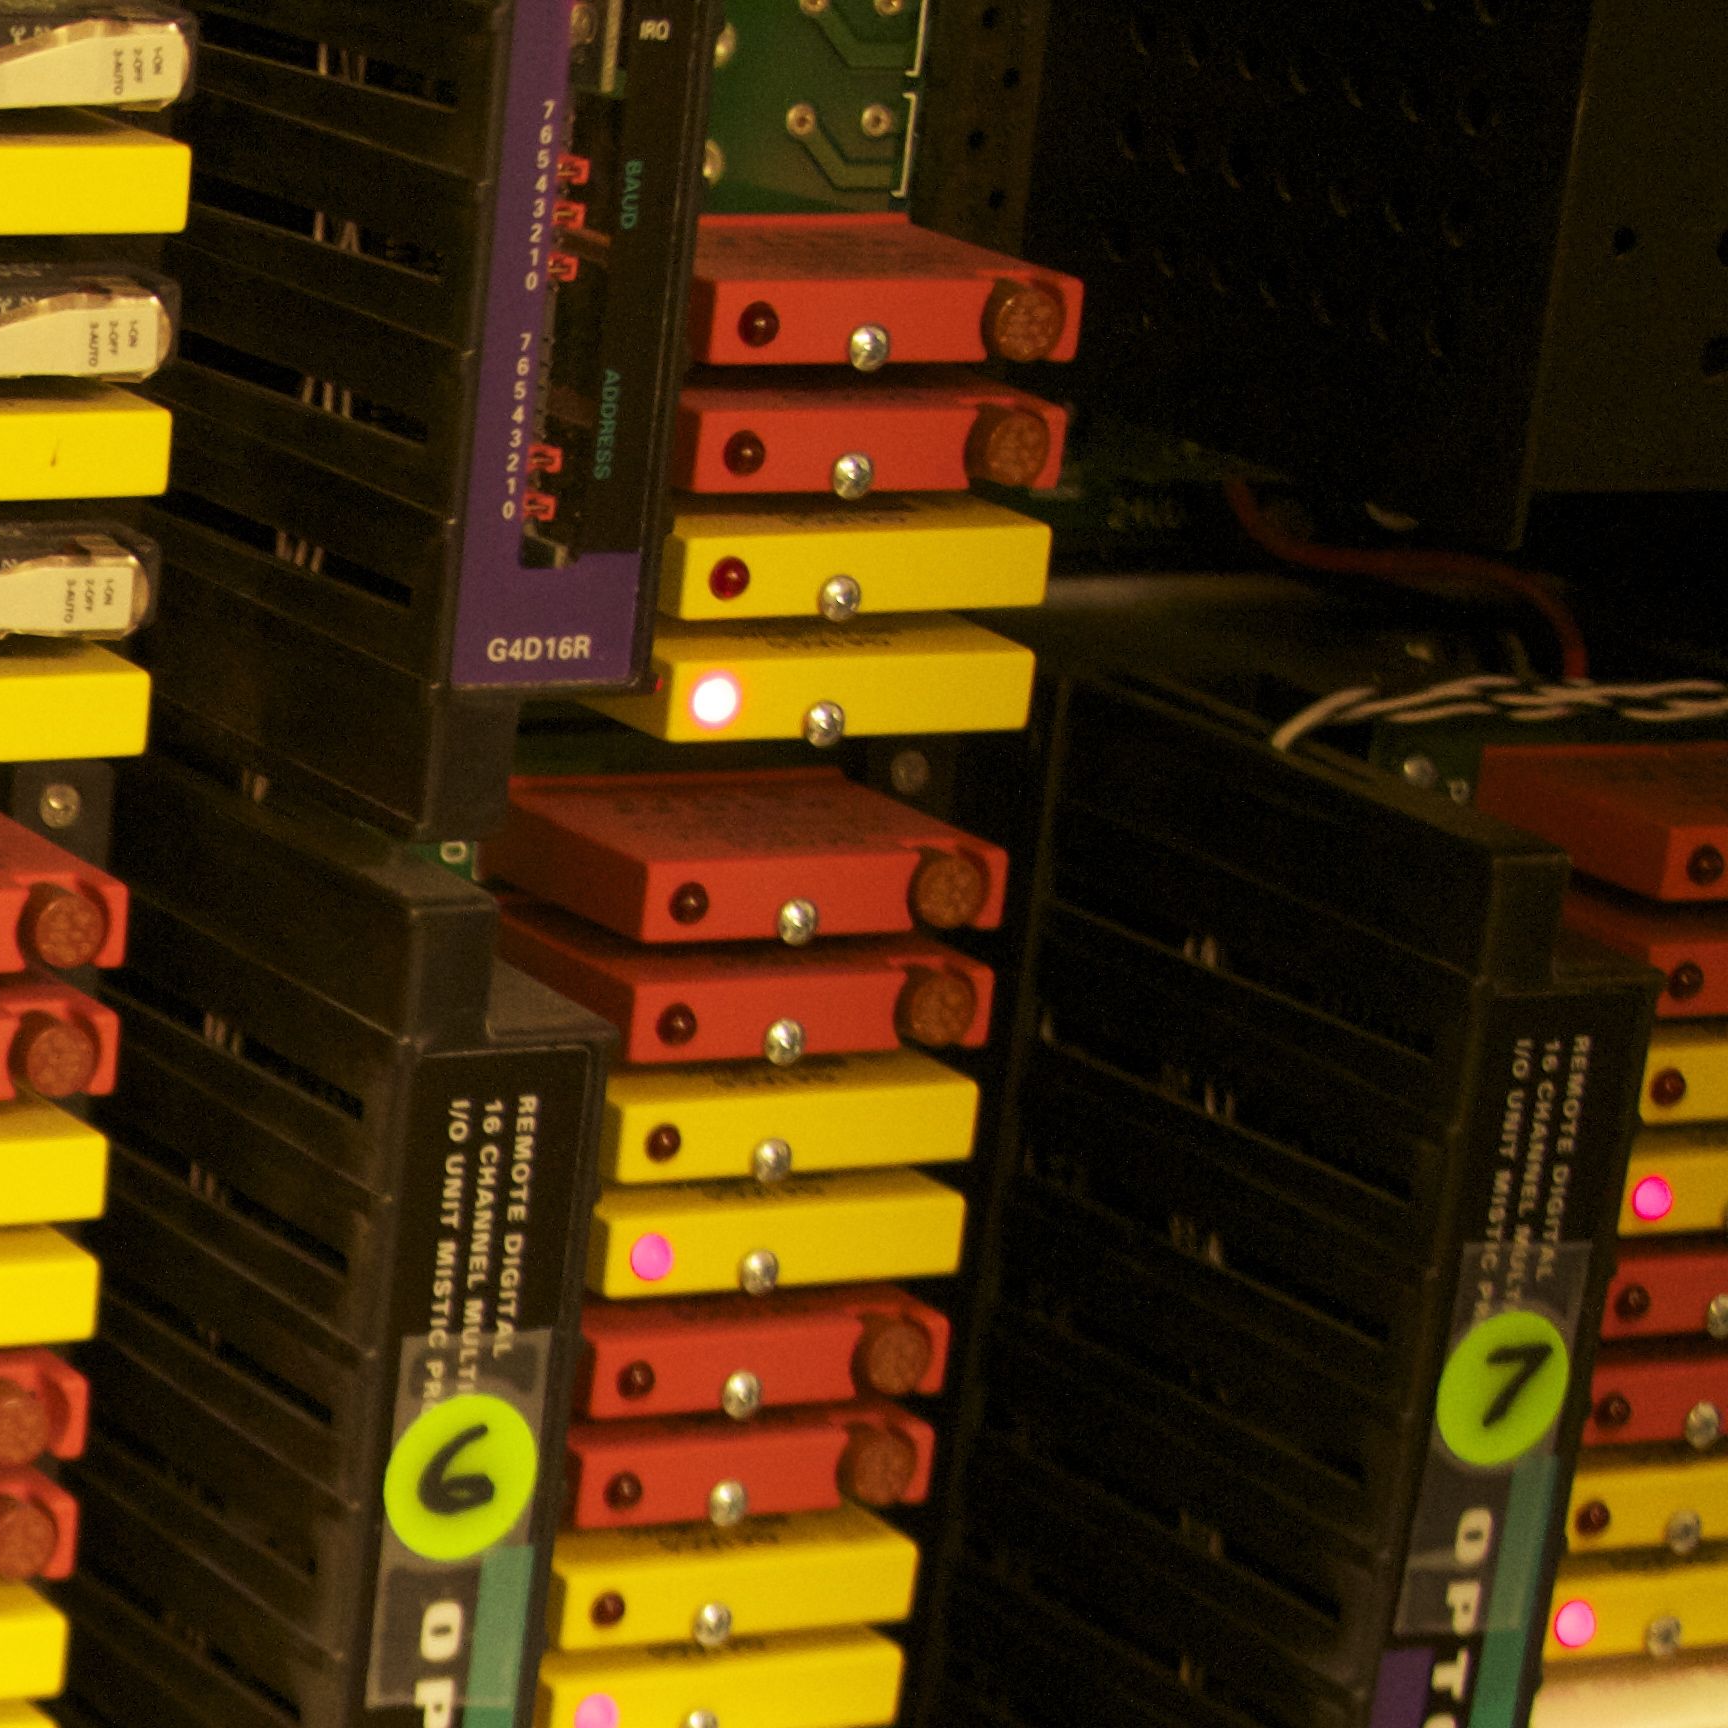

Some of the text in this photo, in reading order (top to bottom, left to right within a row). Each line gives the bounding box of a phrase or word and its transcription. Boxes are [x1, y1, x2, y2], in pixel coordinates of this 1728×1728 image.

[113, 49, 124, 95] 3-AUTO
[133, 49, 144, 83] 2-OFF
[153, 46, 164, 75] 1-ON
[594, 368, 621, 481] ADDRESS
[487, 636, 591, 663] G4D16R
[1498, 1092, 1529, 1161] UNIT
[1557, 1034, 1593, 1154] REMOTE
[1517, 1082, 1557, 1216] CHANNEL
[428, 1100, 470, 1351] I/O UNIT MISTIC
[466, 1102, 503, 1291] 16 CHANNEL
[493, 1094, 538, 1358] REMOTE DIGITAL
[1485, 1343, 1553, 1429] 7
[418, 1423, 495, 1516] 6
